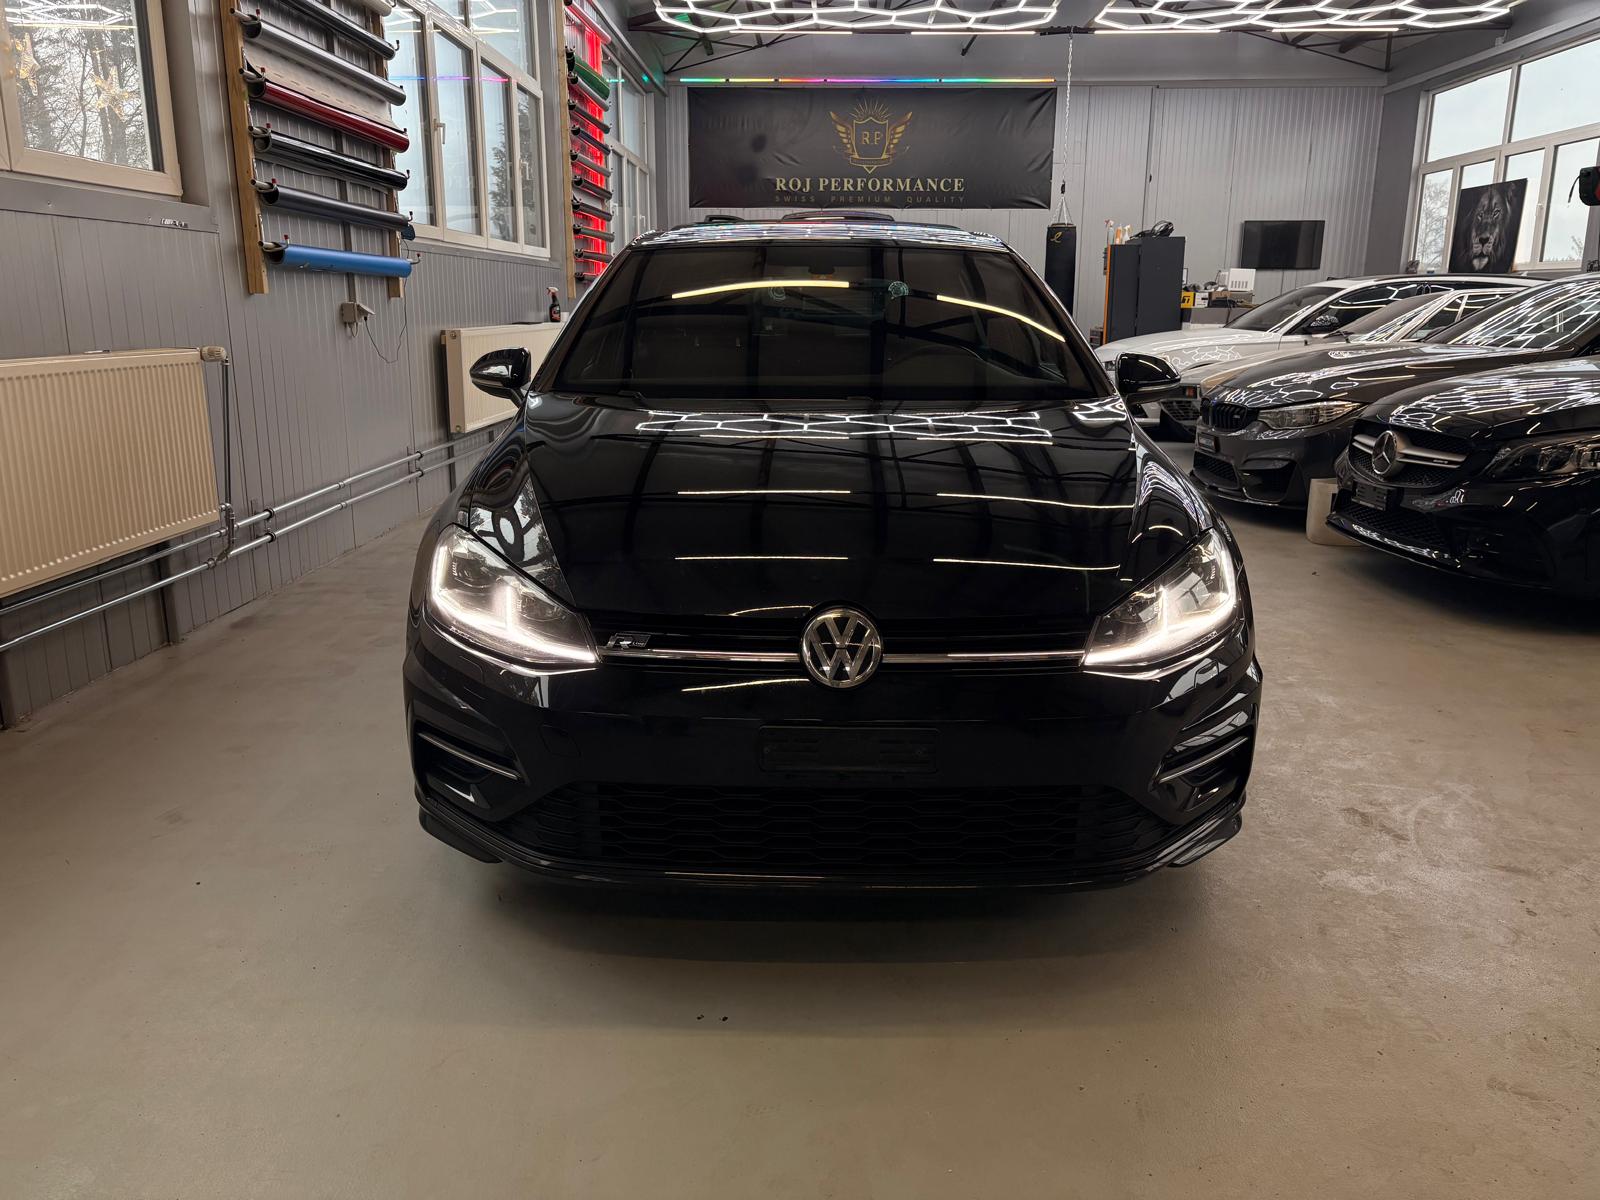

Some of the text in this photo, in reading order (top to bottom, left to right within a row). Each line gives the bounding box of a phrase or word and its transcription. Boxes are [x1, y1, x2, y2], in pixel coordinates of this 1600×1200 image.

[775, 177, 965, 192] ROJ PERFORMANCE
[775, 195, 965, 204] SWISS PREMIUM QUALITY
